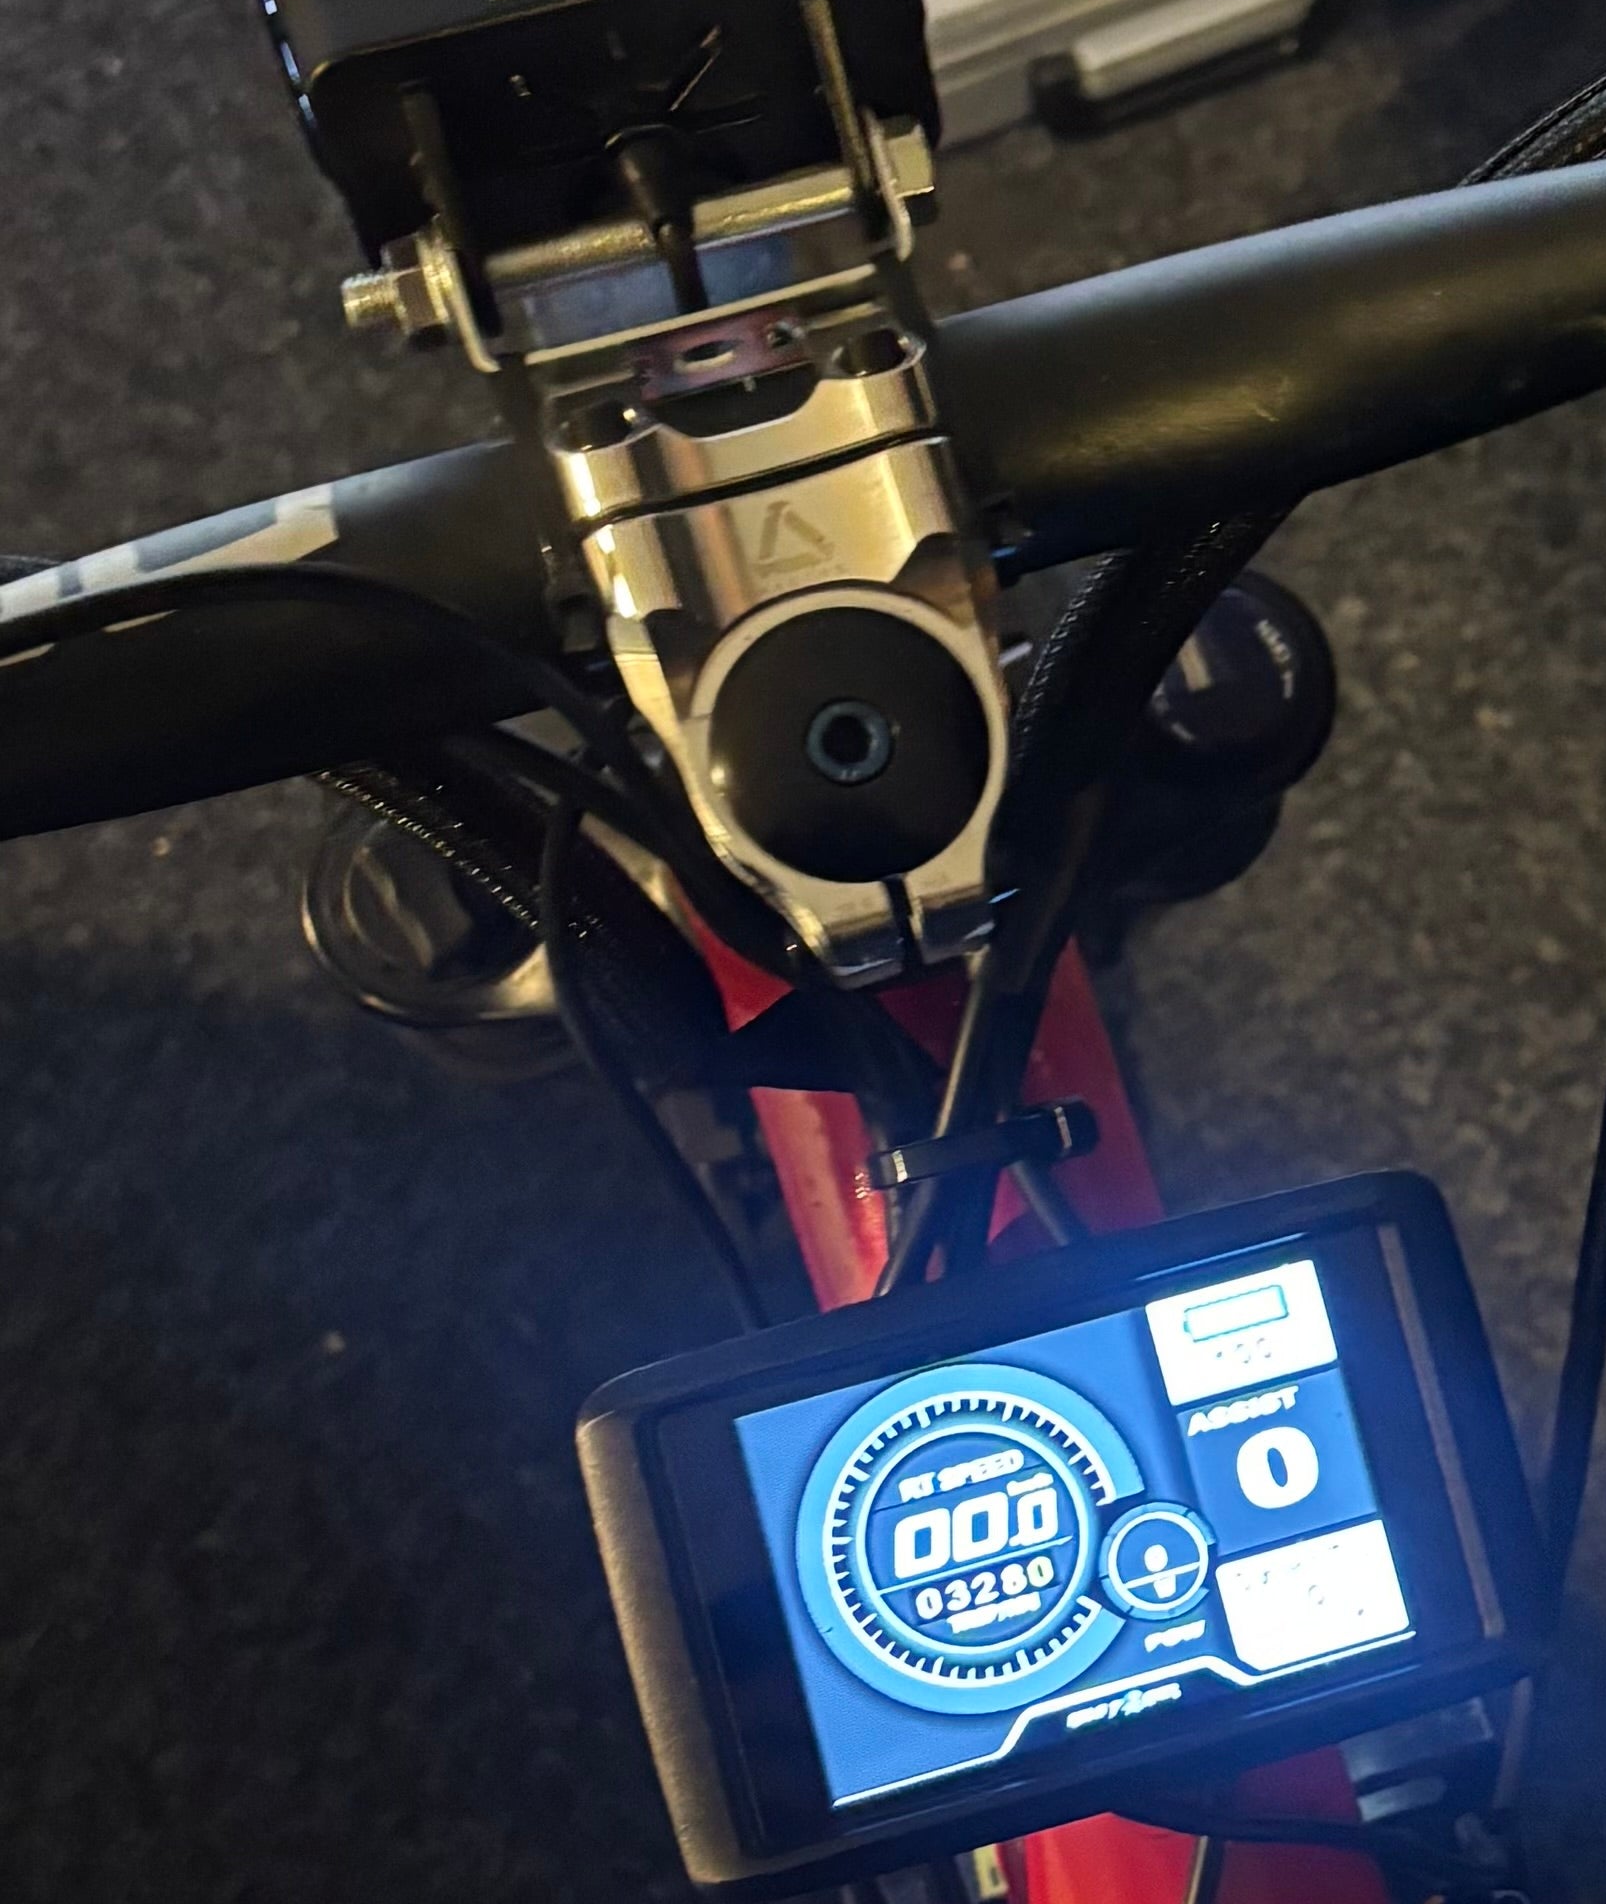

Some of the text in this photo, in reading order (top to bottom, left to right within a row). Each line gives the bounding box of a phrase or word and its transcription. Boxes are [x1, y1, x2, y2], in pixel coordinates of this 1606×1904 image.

[1187, 1385, 1299, 1437] ASSIST
[937, 1449, 1024, 1492] SPEED
[1237, 1426, 1319, 1509] 0
[915, 1556, 1054, 1619] 03280
